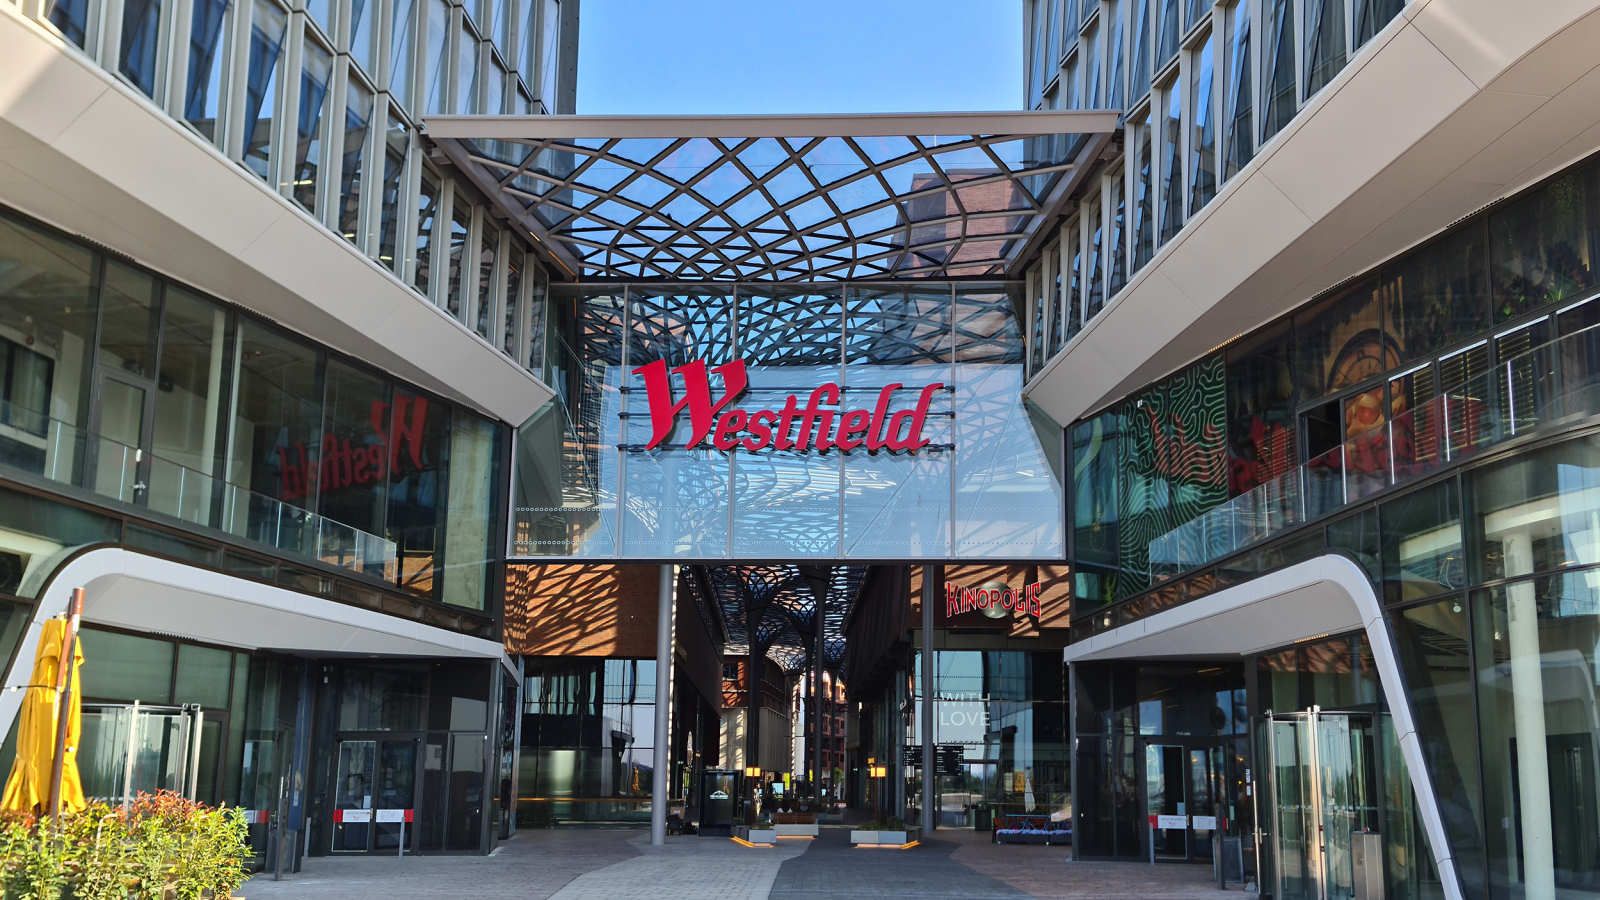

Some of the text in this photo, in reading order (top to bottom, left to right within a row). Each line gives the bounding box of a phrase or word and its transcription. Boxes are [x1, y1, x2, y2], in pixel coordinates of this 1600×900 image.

[632, 358, 944, 451] Westfield
[946, 581, 1041, 618] KINOPOLIS
[940, 693, 991, 707] WITH
[941, 711, 991, 726] LOVE
